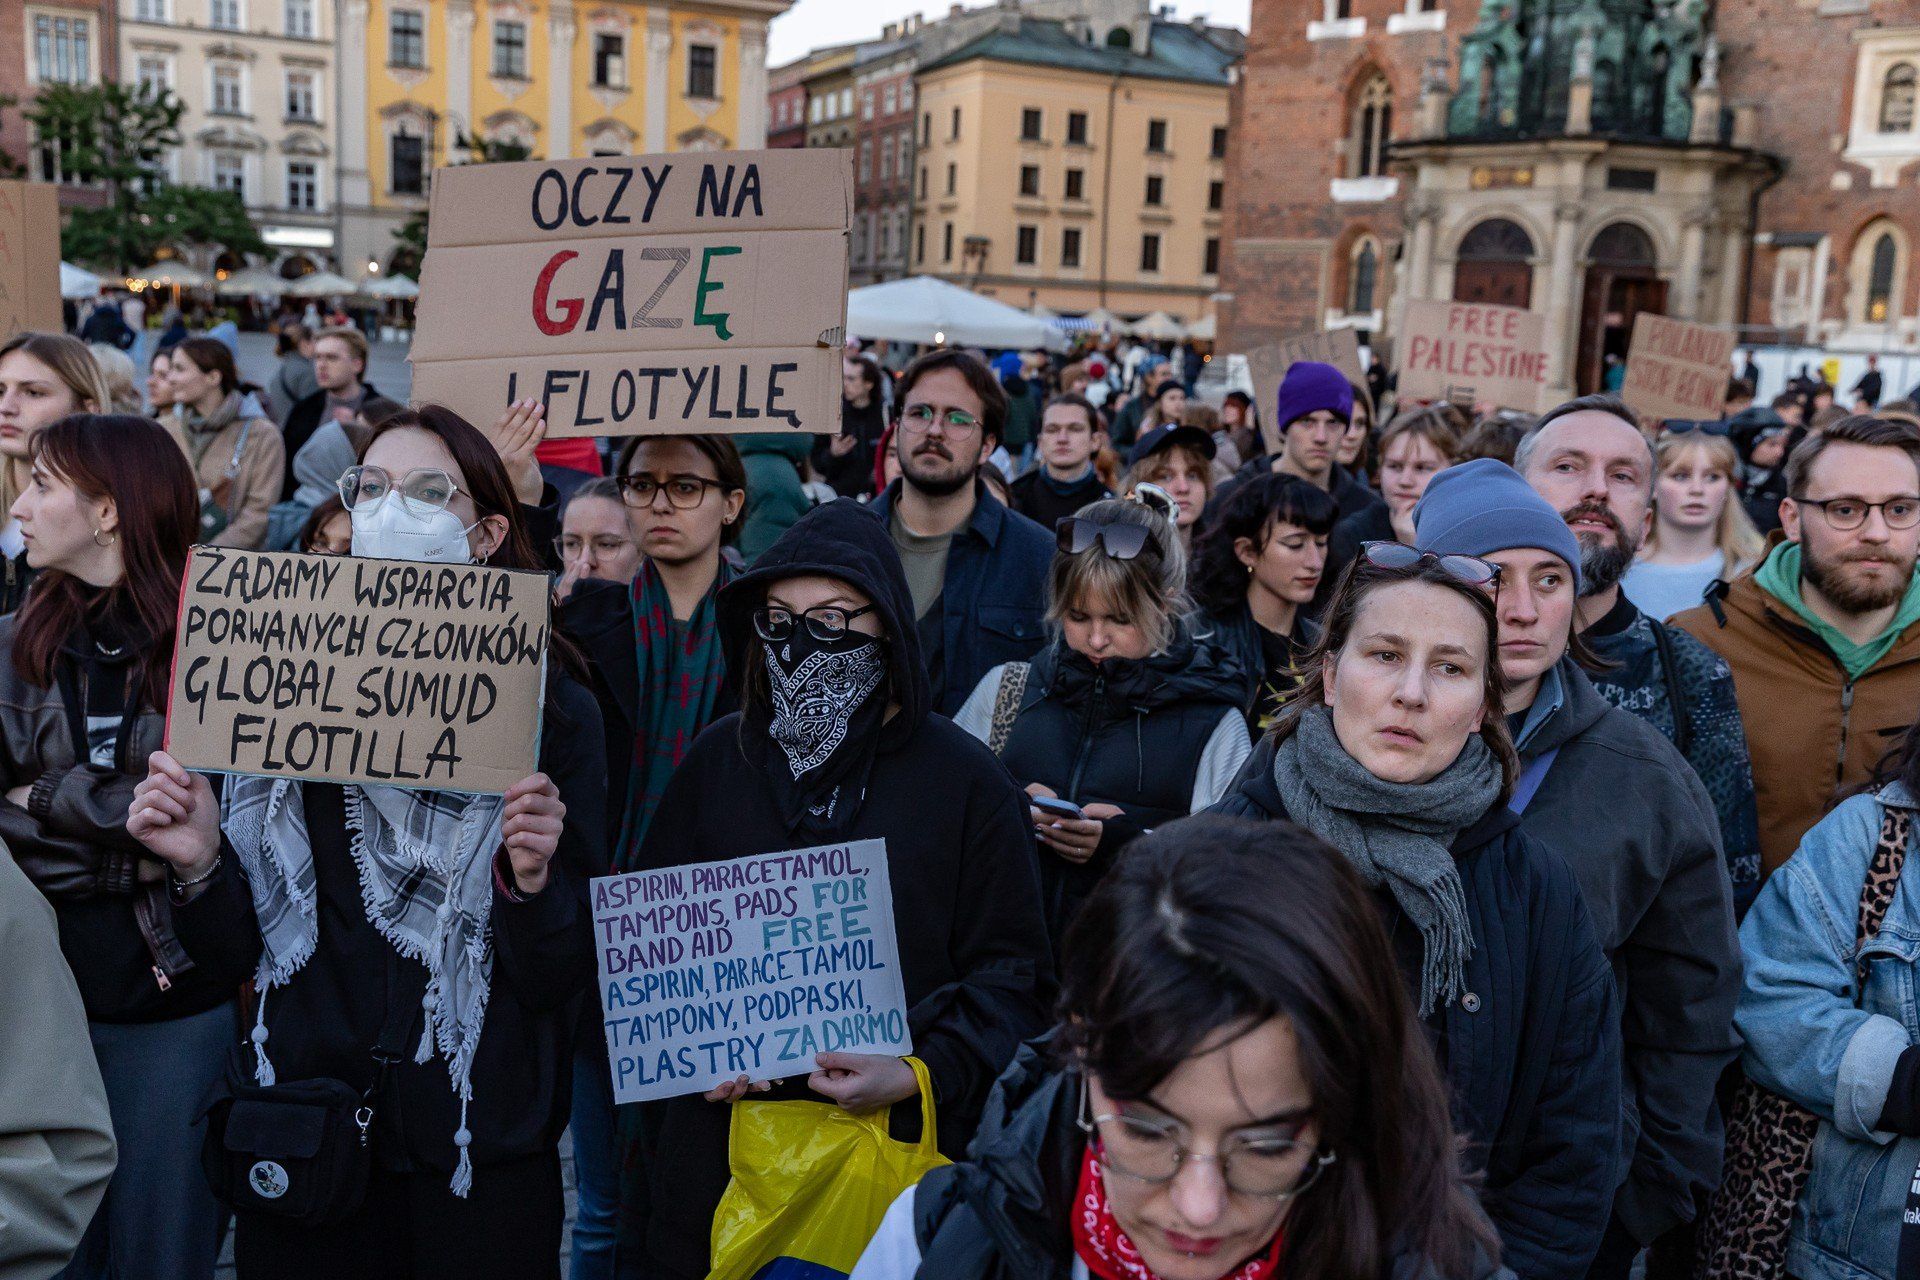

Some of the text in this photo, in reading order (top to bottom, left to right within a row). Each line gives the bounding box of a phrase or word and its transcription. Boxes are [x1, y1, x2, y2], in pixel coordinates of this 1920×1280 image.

[532, 163, 764, 231] OCZY NA
[532, 246, 743, 341] GAZĘ
[1447, 306, 1521, 340] FREE
[507, 362, 803, 429] I FLOTYLLĘ
[196, 547, 514, 614] ŻĄDAMY WSPARCIA
[424, 547, 444, 558] KN95
[185, 604, 545, 666] PORWANYCH CZŁONKÓW
[185, 655, 498, 726] GLOBAL SUMUD
[231, 712, 463, 780] FLOTILLA
[596, 847, 870, 911] ASPIRIN, PARACETAMOL,
[597, 875, 868, 944] TAMPONS, PADS FOR
[605, 905, 872, 975] BAND AID FREE
[607, 939, 885, 1011] ASPIRIN, PARACETAMOL
[605, 979, 873, 1048] TAMPONY, PODPASKI,
[617, 1007, 905, 1090] PLASTRY ZA DARMO
